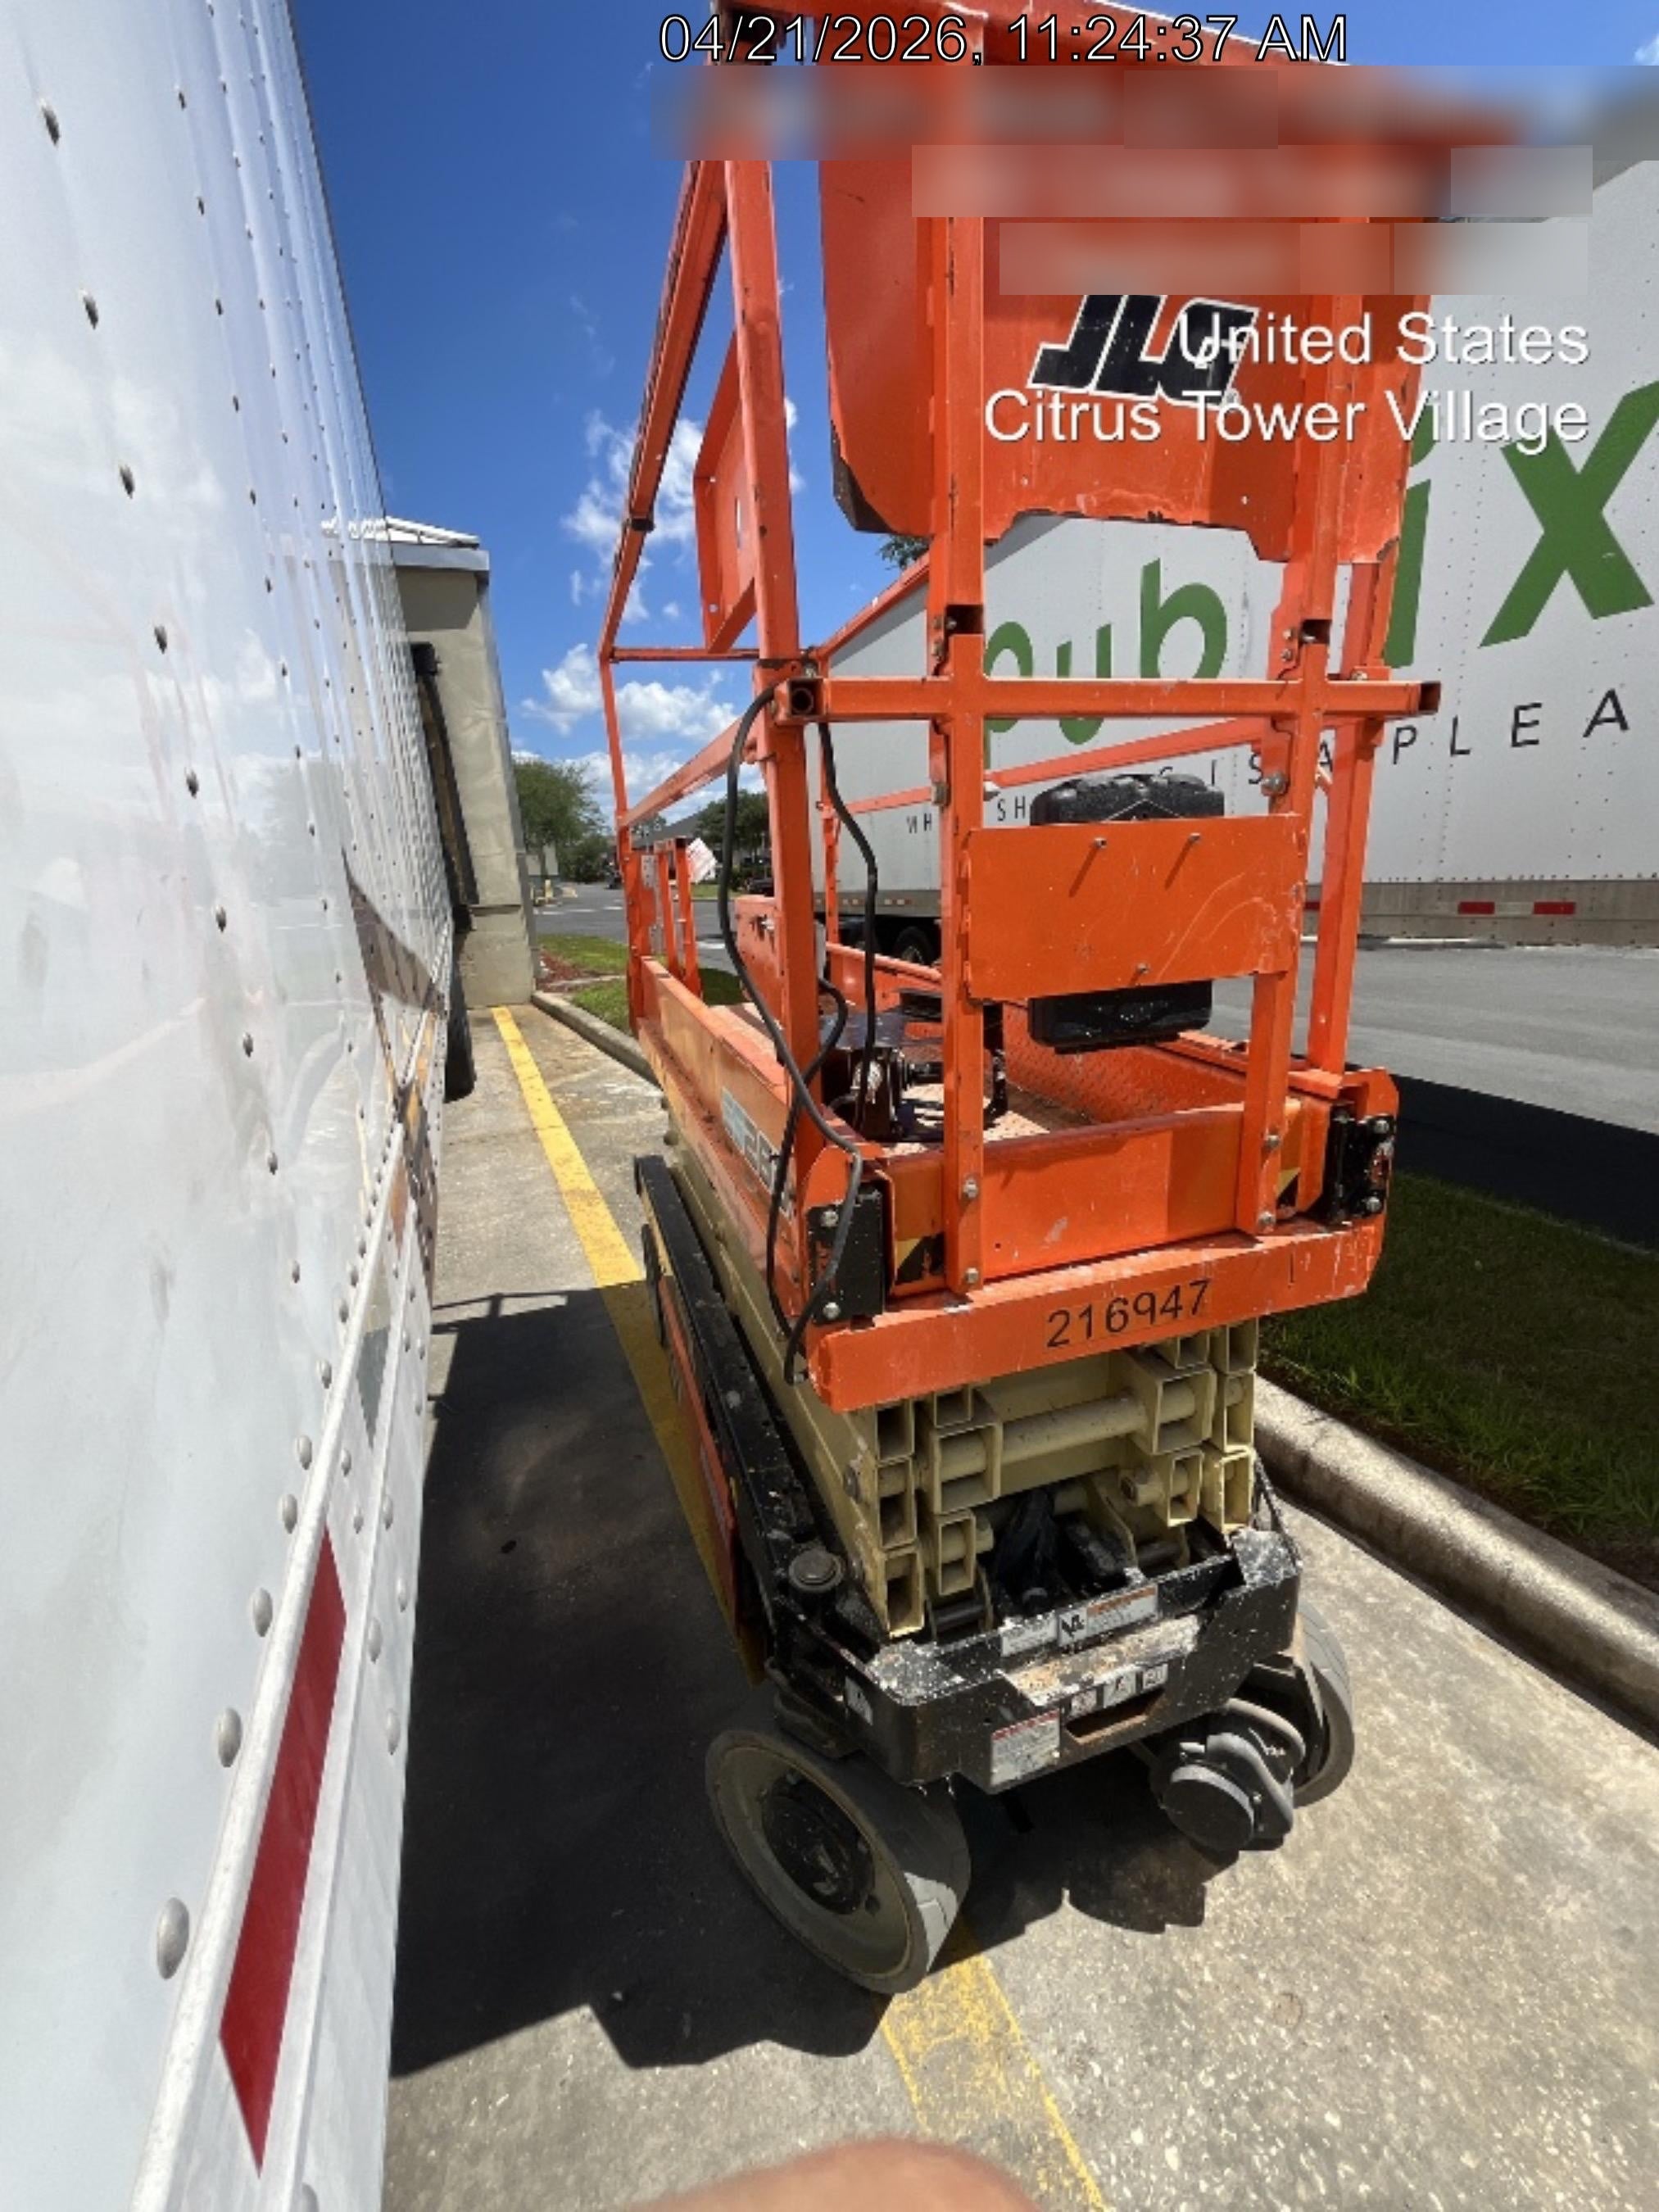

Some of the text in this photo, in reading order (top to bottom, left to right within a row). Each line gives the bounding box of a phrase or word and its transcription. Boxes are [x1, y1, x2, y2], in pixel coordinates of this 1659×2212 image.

[1027, 295, 1260, 411] JLG
[983, 379, 1659, 770] pubix
[1046, 1278, 1211, 1348] 216947
